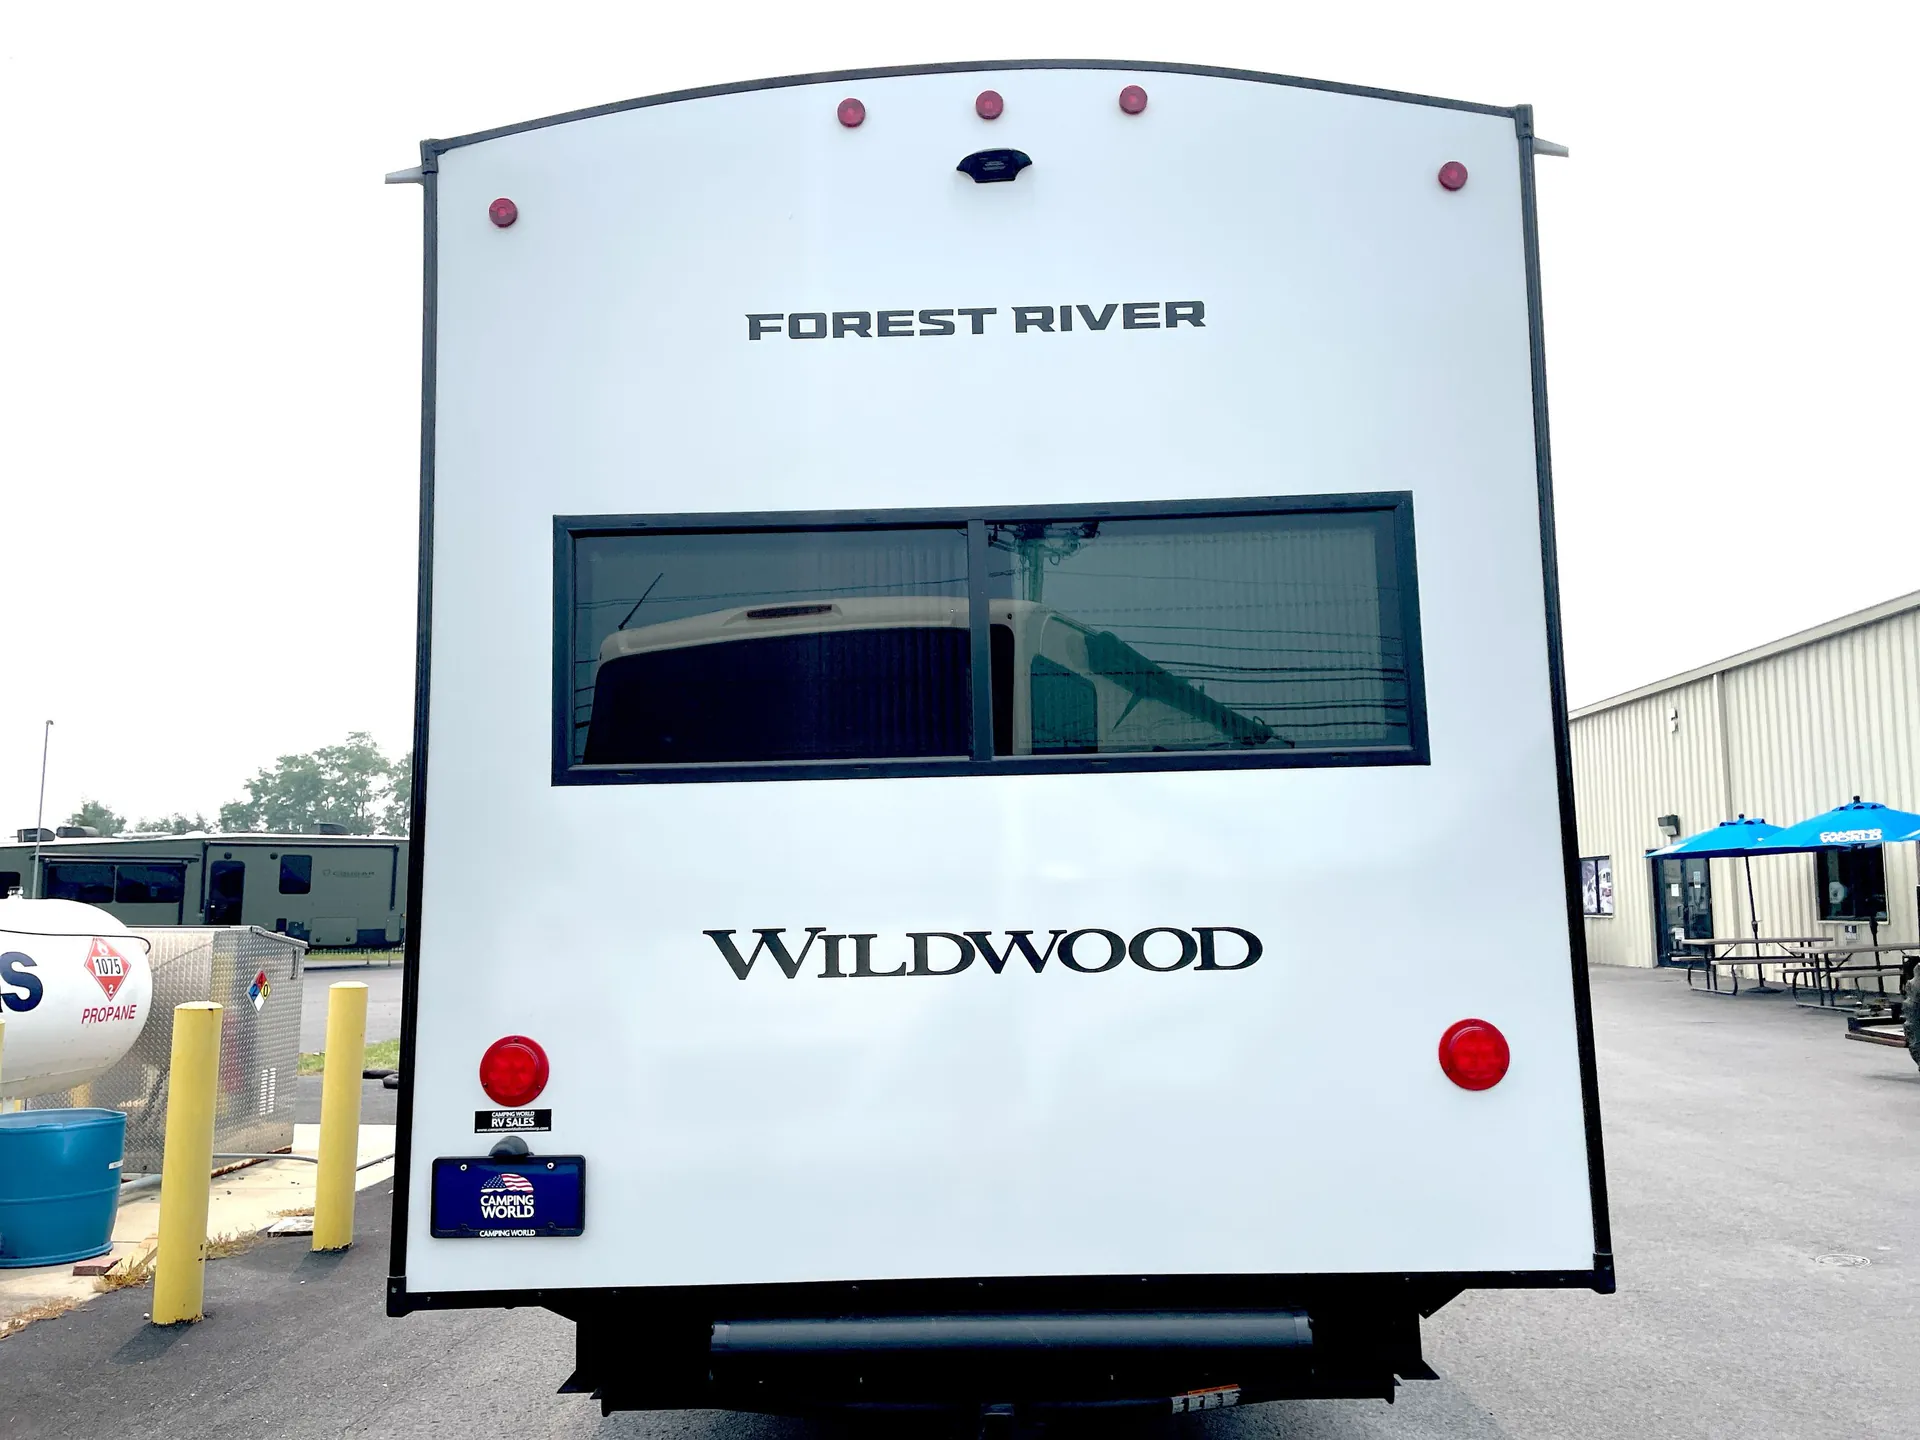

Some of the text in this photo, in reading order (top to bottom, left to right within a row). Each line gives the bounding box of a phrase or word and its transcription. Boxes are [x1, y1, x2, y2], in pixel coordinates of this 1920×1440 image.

[745, 300, 1207, 341] FOREST RIVER
[702, 927, 1264, 981] WILDWOOD
[95, 958, 121, 975] 1075
[0, 951, 44, 1013] S
[107, 984, 114, 994] 2
[81, 1004, 137, 1024] PROPANE
[491, 1117, 535, 1128] RV SALES
[480, 1194, 534, 1206] CAMPING
[481, 1205, 535, 1219] WORLD
[510, 1229, 536, 1237] WORLD
